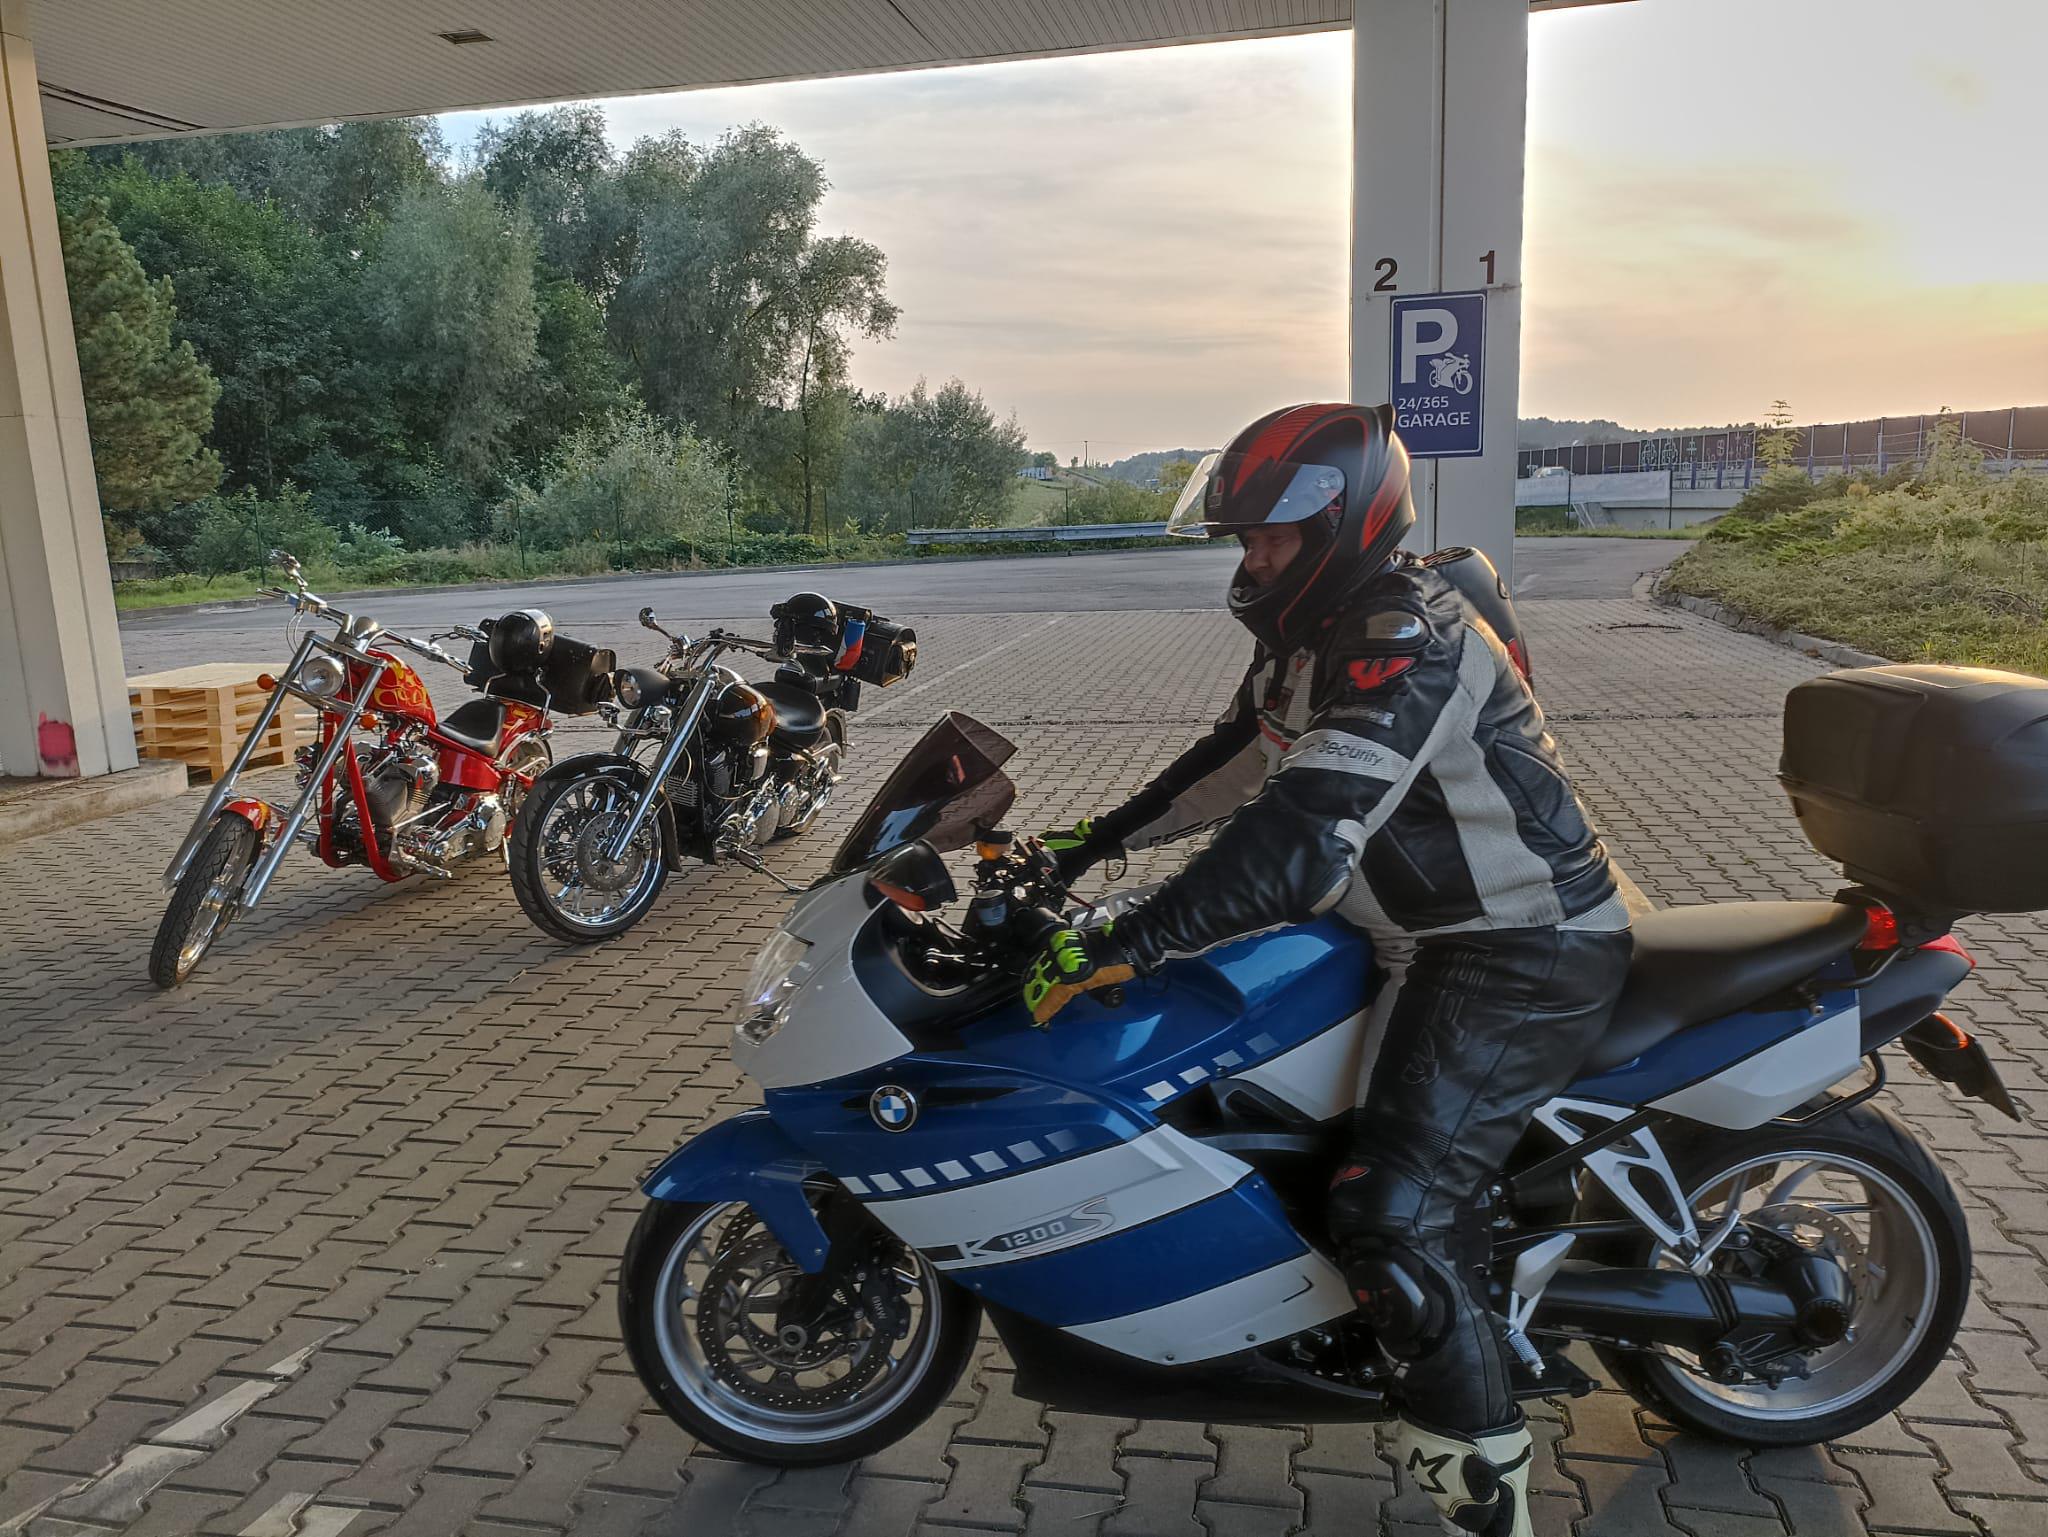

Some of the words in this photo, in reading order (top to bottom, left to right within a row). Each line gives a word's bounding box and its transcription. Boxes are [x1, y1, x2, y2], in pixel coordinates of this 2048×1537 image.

[1373, 257, 1398, 292] 2
[1479, 250, 1495, 284] 1
[1400, 308, 1459, 384] P
[1397, 395, 1449, 411] 24/365
[1397, 411, 1471, 428] GARAGE
[1000, 1220, 1067, 1249] 1200
